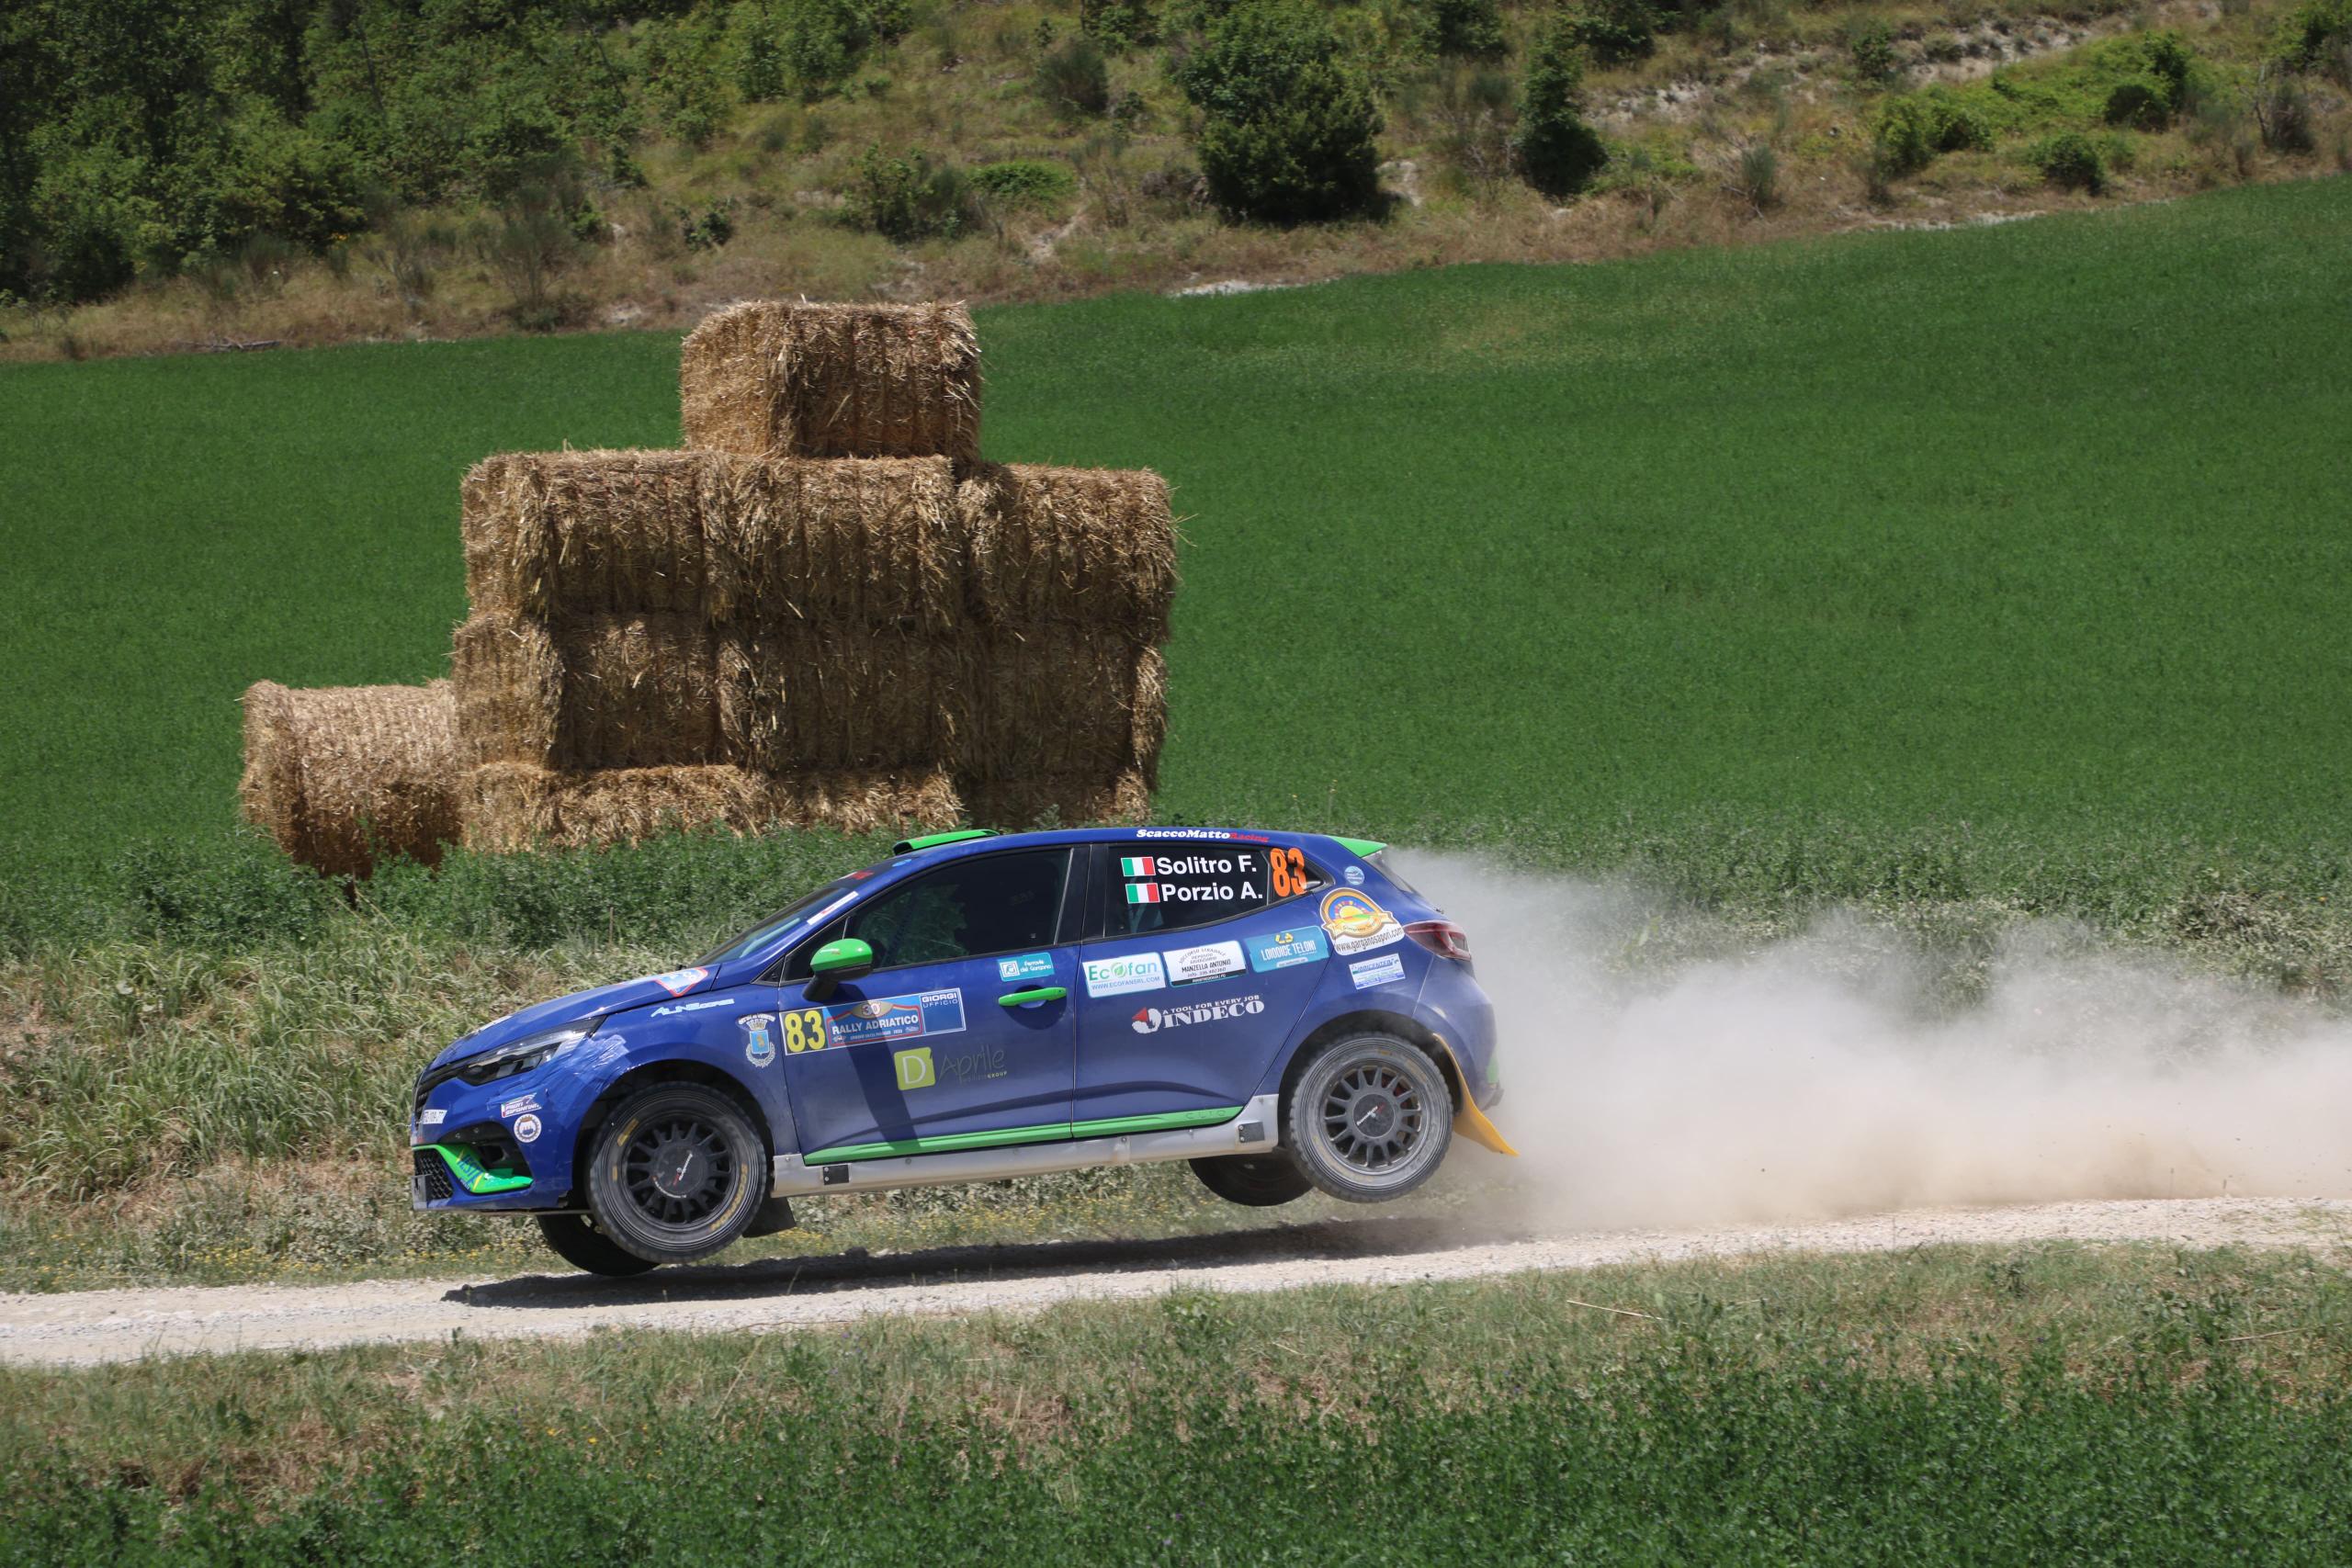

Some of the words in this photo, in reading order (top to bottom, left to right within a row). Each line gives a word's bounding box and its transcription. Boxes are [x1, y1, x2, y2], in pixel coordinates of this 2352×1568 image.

[1157, 856, 1232, 875] Solitro
[1238, 854, 1257, 873] F.
[1270, 847, 1307, 897] 83
[1161, 882, 1234, 902] Porzio
[1240, 881, 1263, 899] A.
[1293, 940, 1317, 954] TELONI
[1182, 963, 1209, 974] MANZELLA
[1209, 959, 1231, 969] ANTONIO
[922, 993, 957, 1003] GIORGI
[922, 998, 958, 1009] UFFICIO
[1171, 1006, 1193, 1014] TOOL
[1215, 997, 1242, 1007] EVERY
[1244, 994, 1261, 1002] JOB
[1160, 999, 1265, 1029] INDECO
[784, 1010, 827, 1054] 83
[831, 1021, 863, 1036] RALLY
[865, 1014, 920, 1032] ADRIATICO
